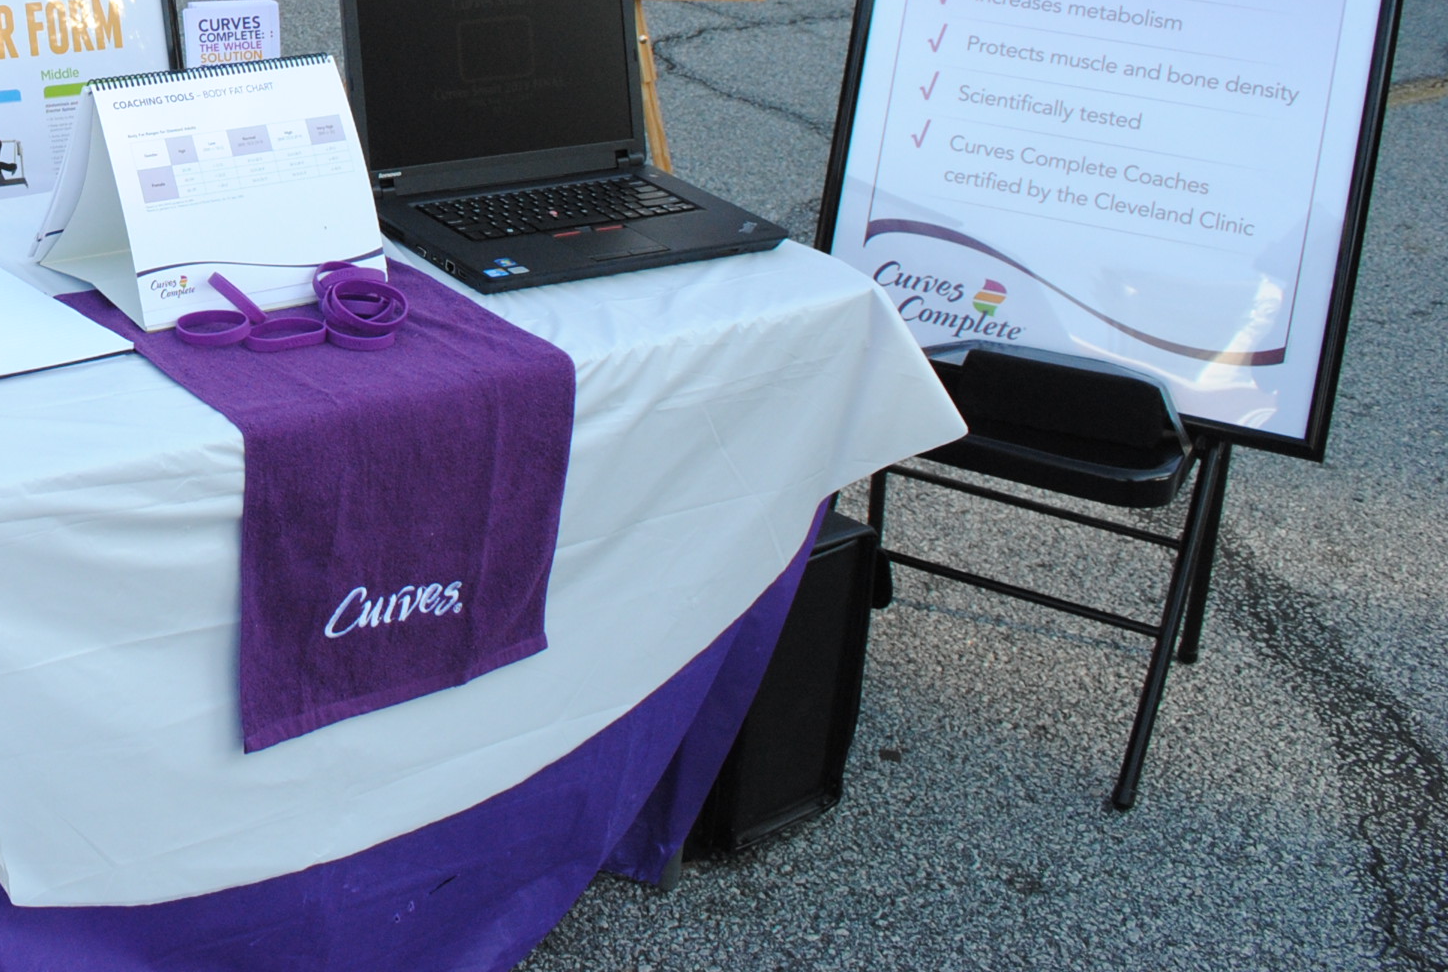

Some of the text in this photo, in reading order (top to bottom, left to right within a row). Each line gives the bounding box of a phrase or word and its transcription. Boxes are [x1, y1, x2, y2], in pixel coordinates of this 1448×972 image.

[198, 15, 261, 32] CURVES
[1068, 2, 1184, 32] metabolism
[199, 29, 265, 44] COMPLETE:
[199, 40, 263, 53] THE WHOLE
[200, 50, 263, 64] SOLUTION
[967, 35, 1301, 107] Protects muscle and bone density
[40, 67, 80, 81] Middle
[112, 82, 274, 110] COACHING TOOLS BODY FAT CHART
[958, 84, 1143, 131] Scientifically tested
[949, 134, 1210, 196] Curves Complete Coaches
[944, 168, 1255, 237] certified by the Cleveland Clinic
[150, 278, 177, 291] Curves
[160, 284, 196, 300] Complete
[873, 260, 965, 303] Curves
[898, 295, 1022, 341] Complete
[324, 581, 463, 639] Curves
